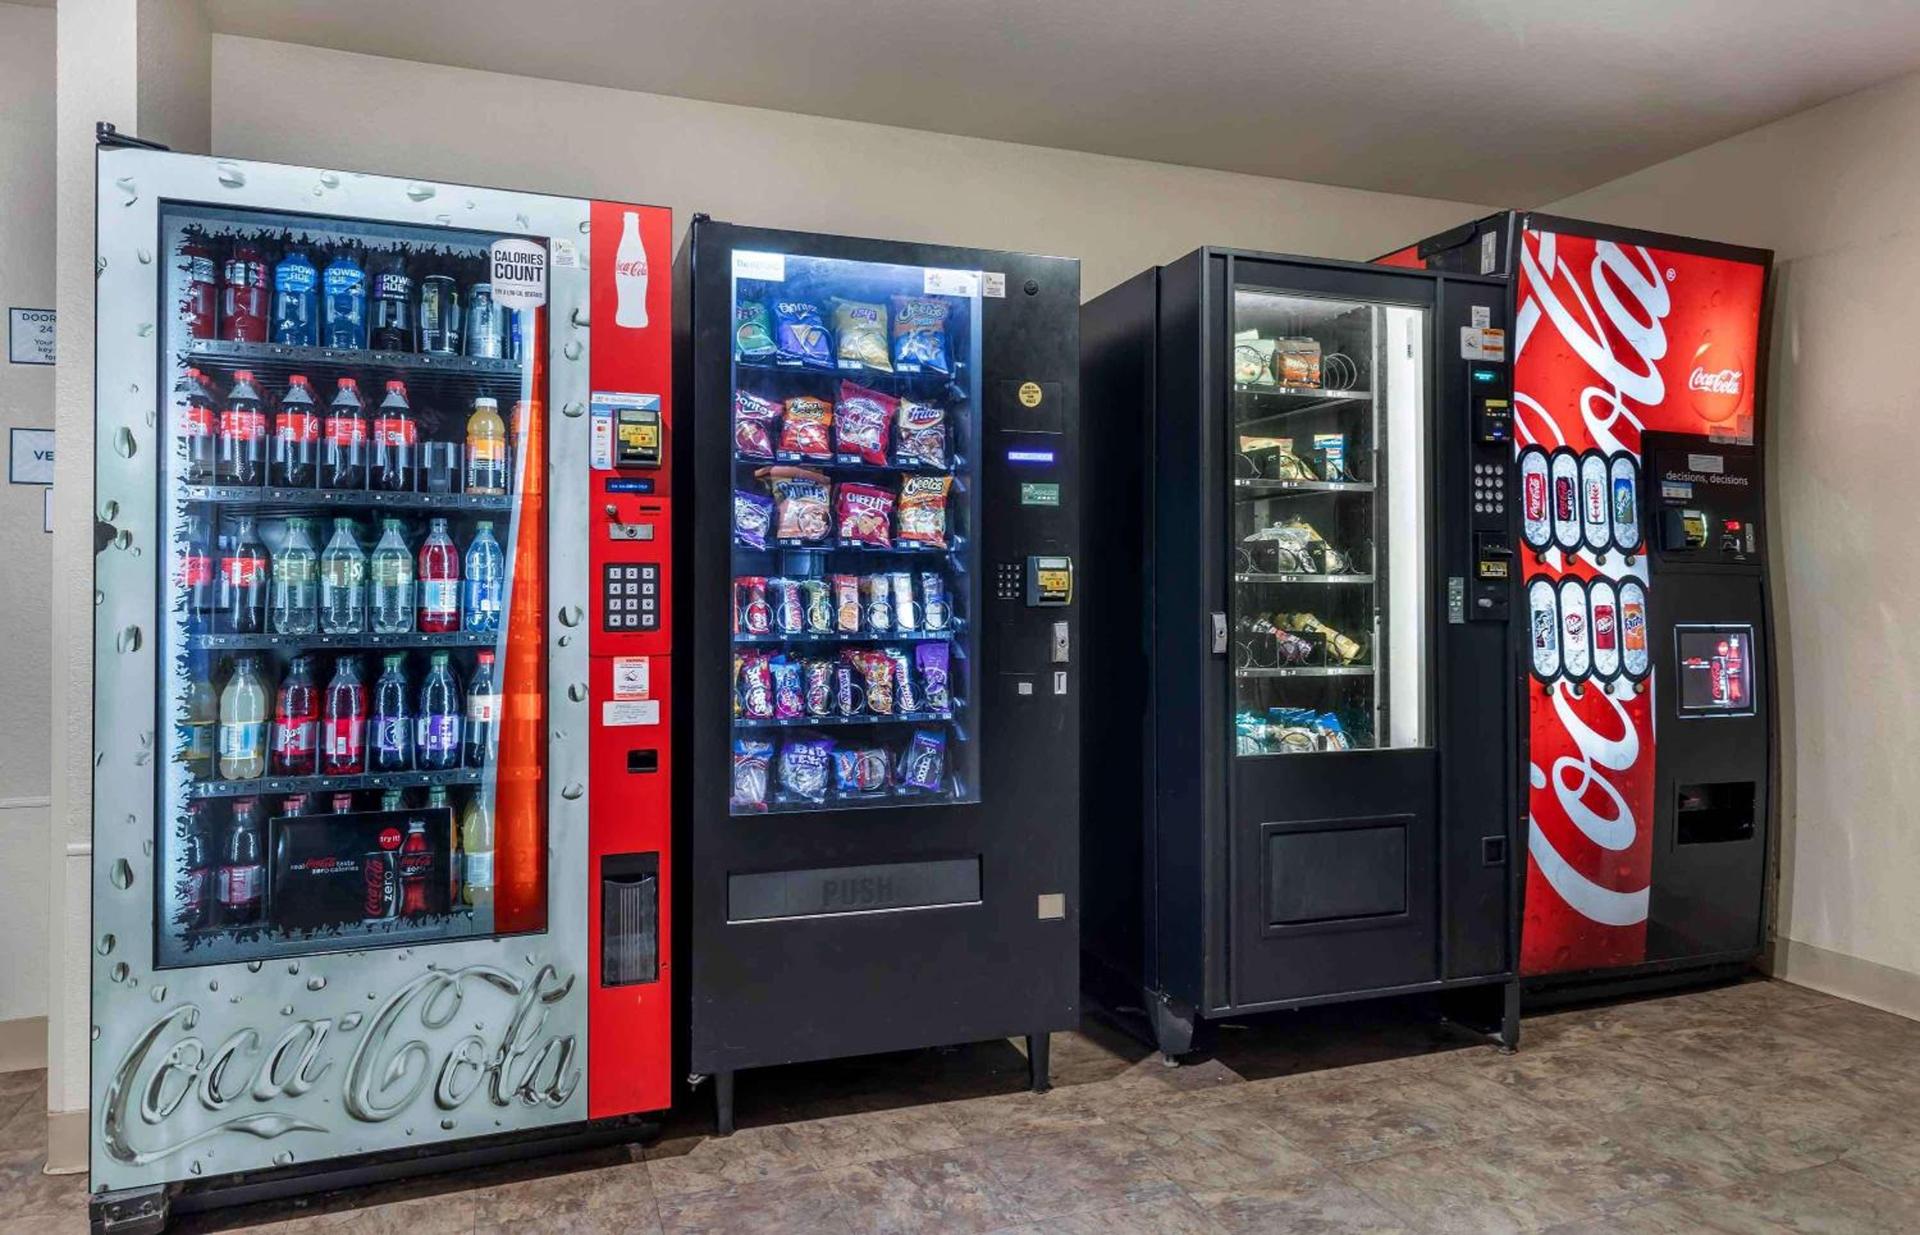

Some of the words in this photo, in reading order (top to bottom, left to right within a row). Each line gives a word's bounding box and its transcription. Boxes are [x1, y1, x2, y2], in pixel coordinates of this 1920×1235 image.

[494, 250, 543, 265] CALORIES
[495, 263, 543, 282] COUNT
[40, 325, 53, 333] 24
[1688, 367, 1743, 394] Coca-Cola
[909, 404, 940, 421] Fritos
[905, 476, 943, 494] Cheetos
[1666, 470, 1708, 484] decisions,
[1710, 473, 1749, 486] decisions
[794, 743, 827, 757] BIG
[379, 835, 391, 843] try
[330, 865, 359, 873] calories
[364, 858, 384, 916] Coca-Cola
[384, 870, 394, 902] zero
[822, 875, 893, 906] PUSH
[101, 963, 583, 1167] Coca-Cola
